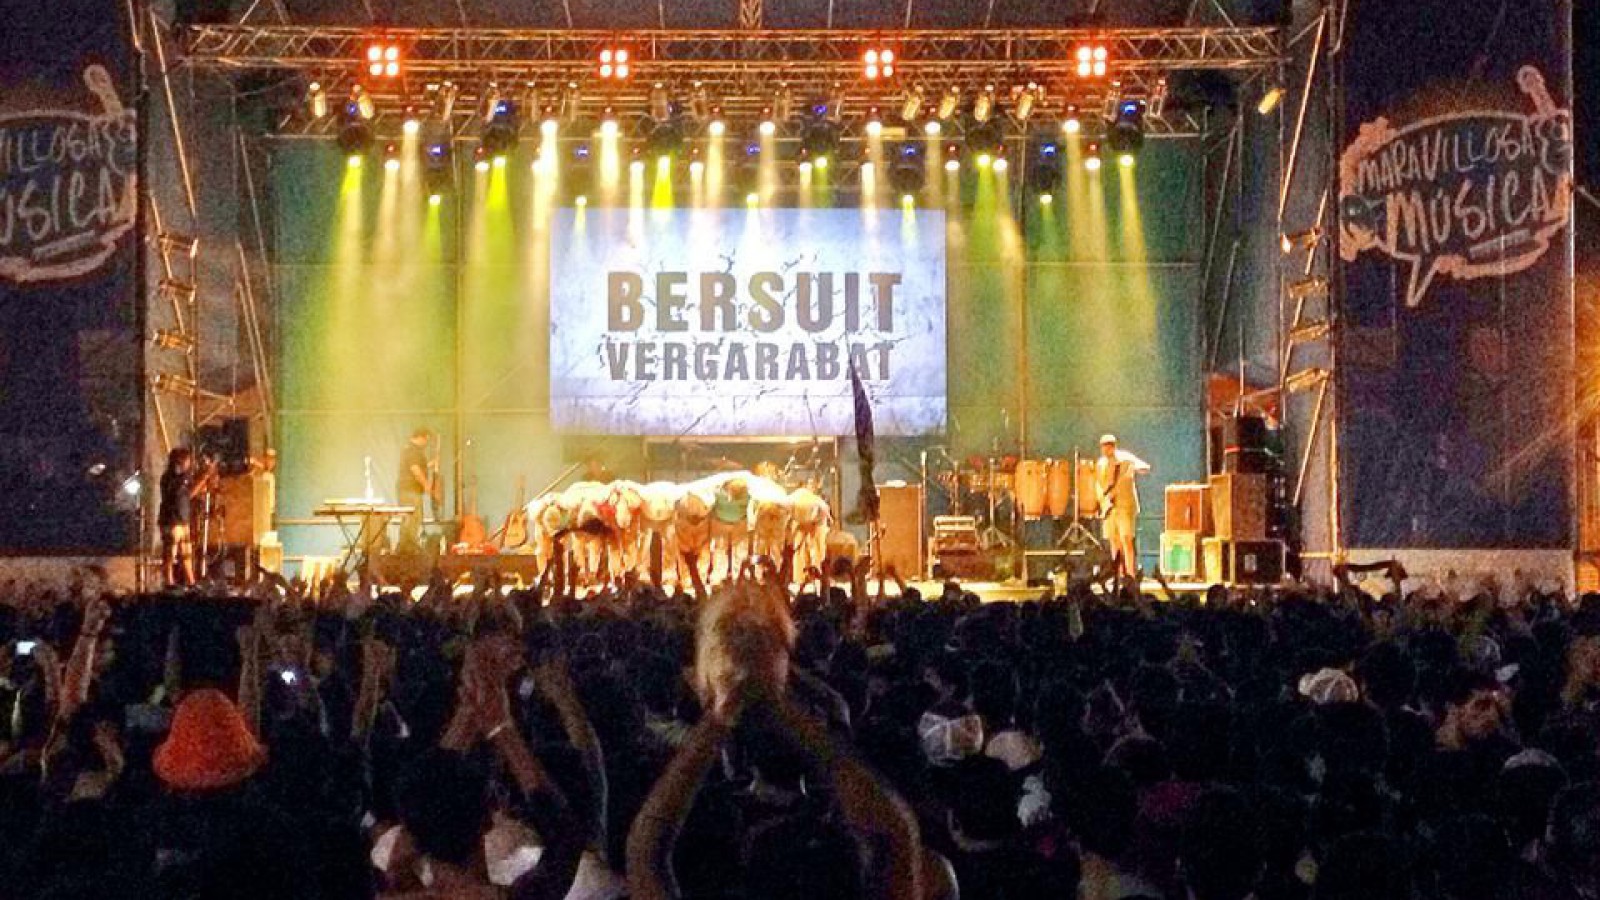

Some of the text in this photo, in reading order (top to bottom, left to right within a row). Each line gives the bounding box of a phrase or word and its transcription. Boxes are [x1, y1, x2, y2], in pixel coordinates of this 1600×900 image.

[0, 121, 102, 171] ILLOSA
[1357, 122, 1536, 193] MARAVILLOSA
[1385, 165, 1551, 254] MÚSICA
[606, 271, 903, 334] BERSUIT
[605, 341, 895, 382] VERGARABAT
